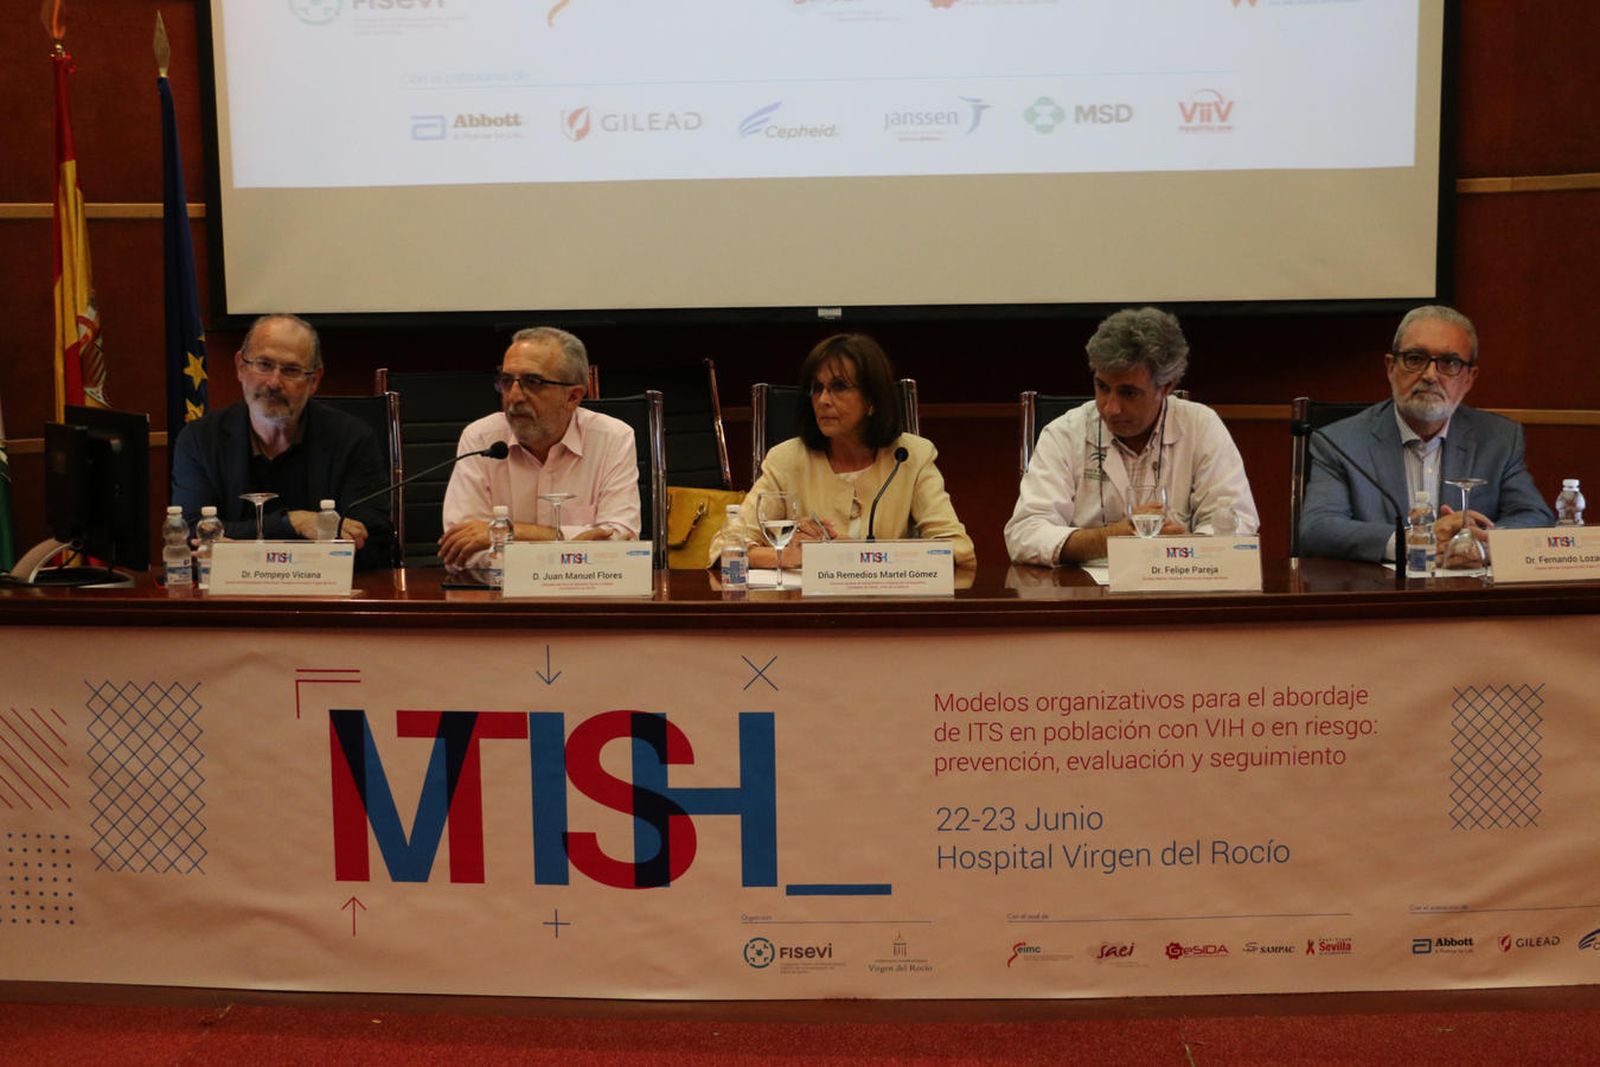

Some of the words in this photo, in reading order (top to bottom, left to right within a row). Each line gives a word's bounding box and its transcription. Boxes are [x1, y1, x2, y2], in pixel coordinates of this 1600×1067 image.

[453, 112, 522, 128] Abbott
[1073, 103, 1134, 124] MSD
[600, 112, 703, 133] GILEAD
[1539, 555, 1578, 564] Fernando
[254, 571, 291, 580] Pompeyo
[292, 571, 322, 579] Viciana
[543, 572, 563, 581] Juan
[565, 572, 596, 580] Manuel
[597, 571, 623, 580] Flores
[836, 570, 878, 579] Remedios
[880, 570, 907, 579] Martel
[1165, 565, 1190, 576] Felipe
[1192, 565, 1219, 575] Pareja
[934, 692, 1029, 713] Modelos
[1035, 689, 1185, 716] organizativos
[1191, 694, 1241, 713] para
[1247, 686, 1265, 708] el
[1272, 684, 1369, 711] abordaje
[934, 723, 961, 742] de
[967, 722, 1004, 742] ITS
[1010, 727, 1037, 741] en
[1043, 719, 1151, 746] población
[1158, 723, 1199, 740] con
[1205, 718, 1245, 737] VIH
[1251, 723, 1265, 737] o
[1271, 721, 1298, 737] en
[1305, 716, 1378, 741] riesgo:
[934, 750, 1061, 777] prevención,
[1066, 748, 1184, 771] evaluación
[1191, 753, 1203, 773] y
[1209, 746, 1347, 772] seguimiento
[936, 807, 1017, 832] 22-23
[1025, 804, 1104, 832] Junio
[937, 843, 1053, 876] Hospital
[1062, 842, 1151, 875] Virgen
[1160, 840, 1201, 867] del
[1211, 838, 1291, 865] Rocío
[1434, 937, 1474, 947] Abbott
[1515, 936, 1560, 948] GILEAD
